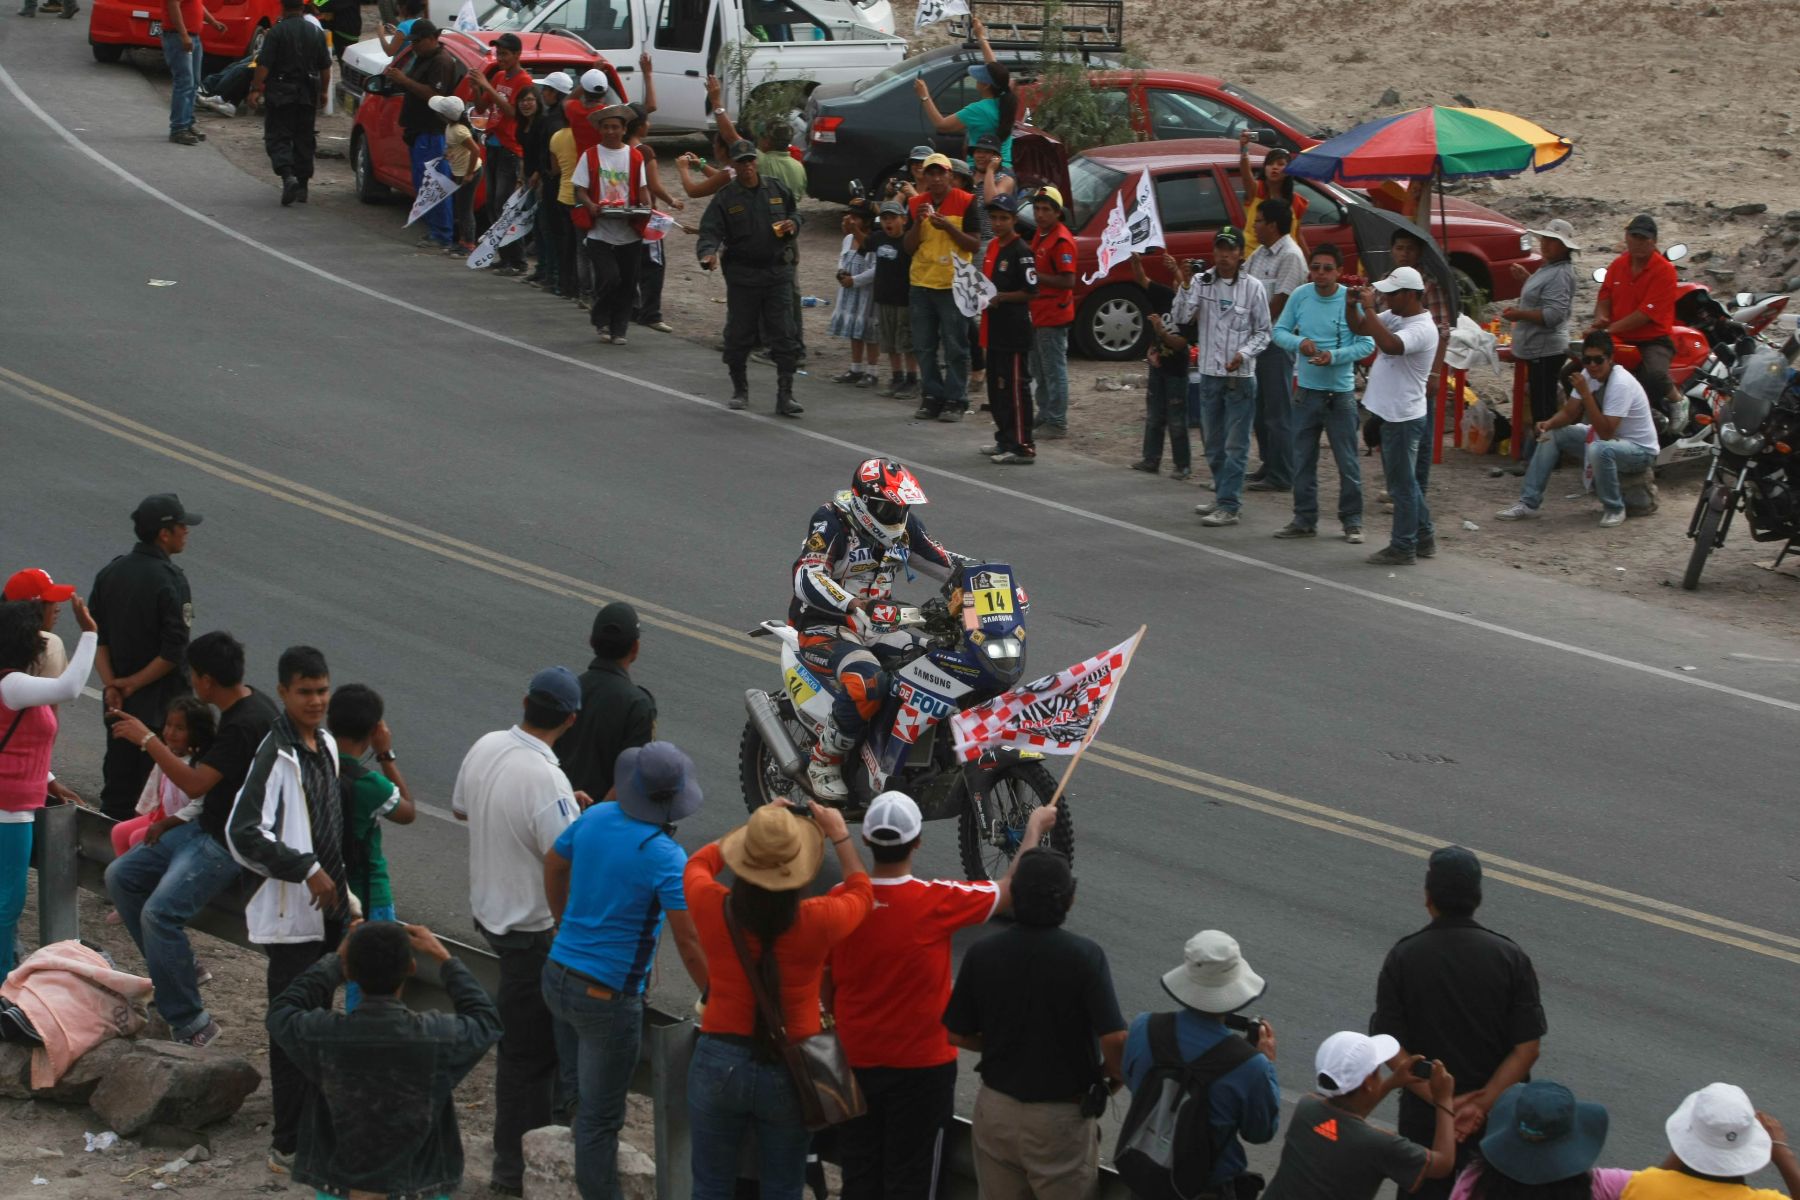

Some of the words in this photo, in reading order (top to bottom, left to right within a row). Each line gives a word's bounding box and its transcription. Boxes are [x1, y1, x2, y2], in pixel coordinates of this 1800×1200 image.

[984, 591, 1005, 612] 14
[982, 614, 1013, 624] SAMSUNG
[800, 669, 819, 691] Macro
[913, 666, 952, 690] SAMSUNG
[1077, 664, 1111, 688] 2013
[899, 689, 911, 700] DE
[910, 689, 949, 719] FOU
